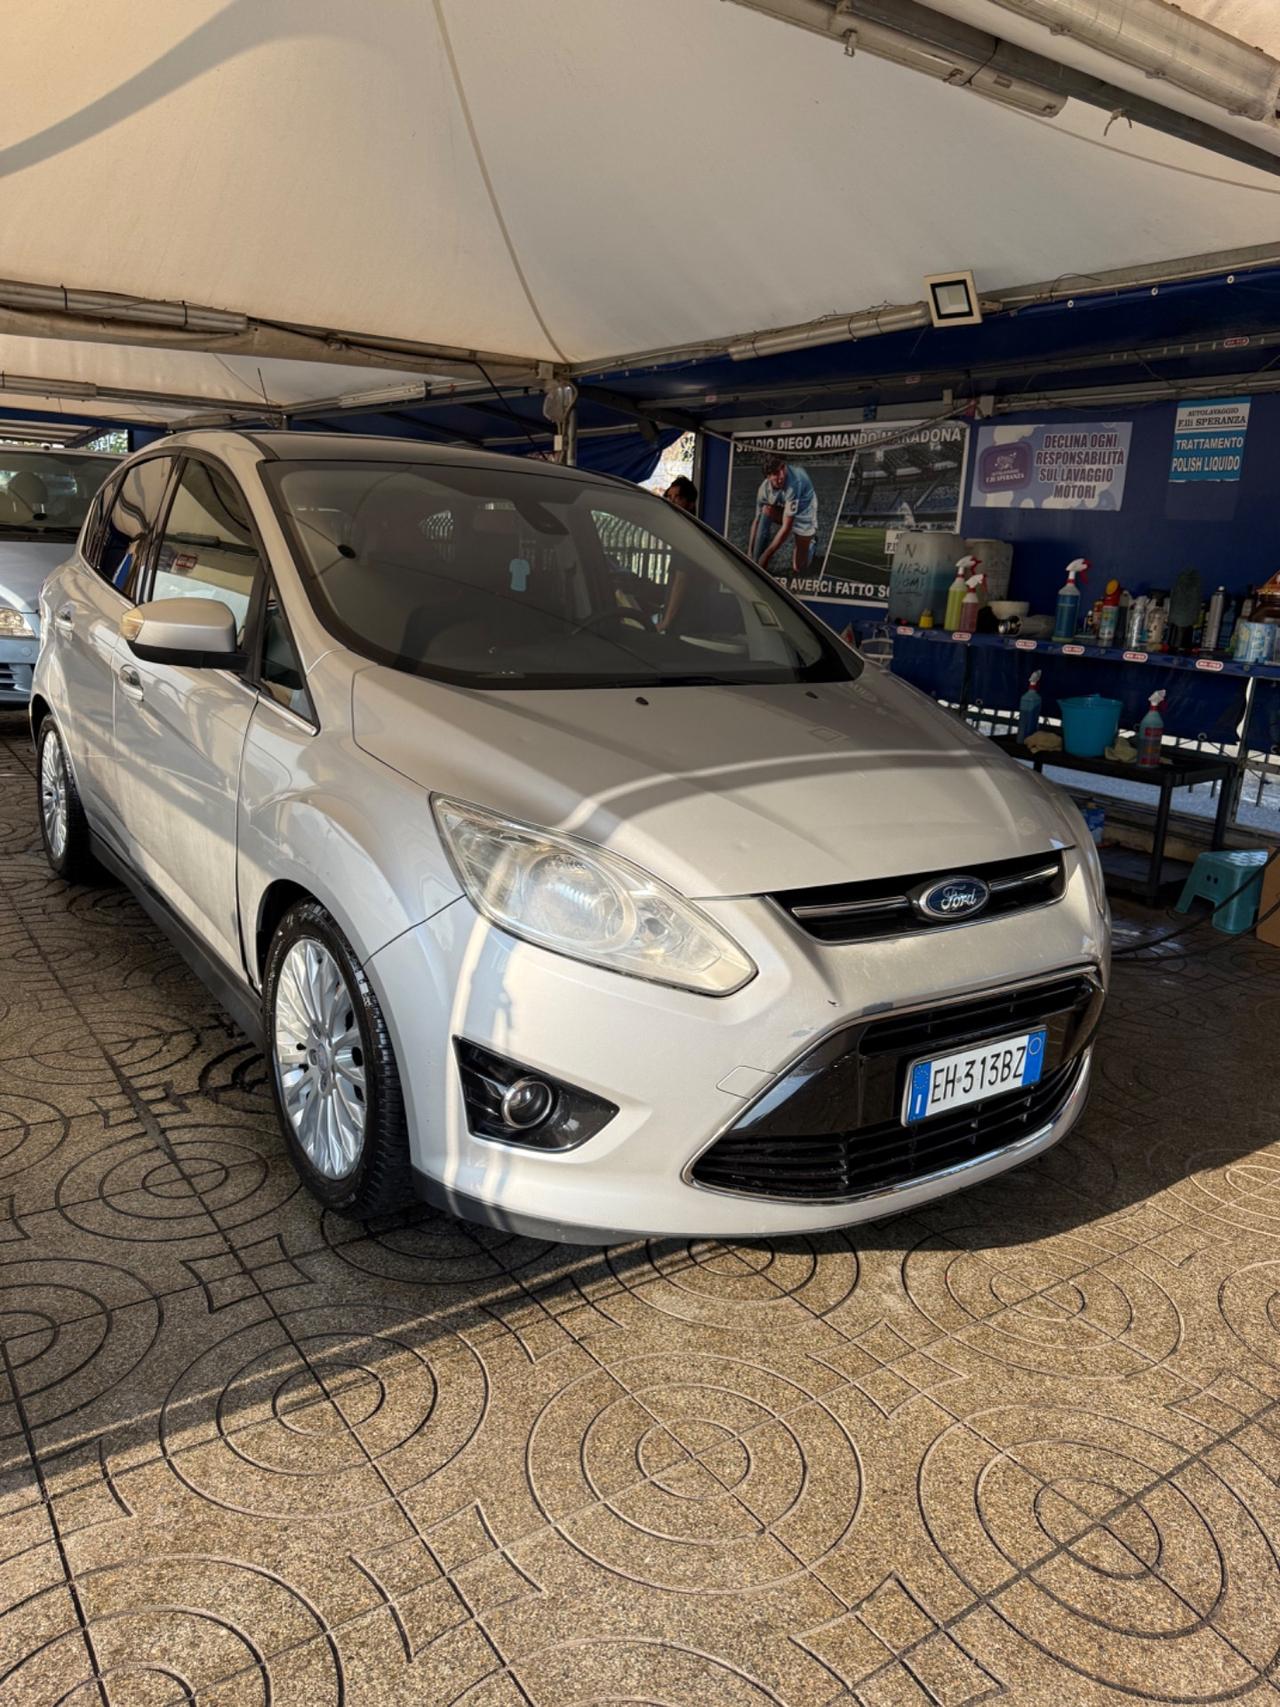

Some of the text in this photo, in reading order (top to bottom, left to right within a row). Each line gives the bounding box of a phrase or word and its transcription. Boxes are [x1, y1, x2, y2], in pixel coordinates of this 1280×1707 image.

[1187, 407, 1239, 417] AUTOLAVAGGIO
[1195, 416, 1246, 426] SPERANZA
[776, 436, 813, 450] DIEGO
[814, 431, 878, 449] ARMANDO
[1044, 433, 1117, 448] DECLINA OGNI
[1175, 437, 1244, 450] TRATTAMENTO
[1035, 448, 1124, 465] RESPONSABILITÀ
[1171, 455, 1240, 472] POLISH LIQUIDO
[1039, 468, 1114, 482] SUL LAVAGGIO
[1053, 484, 1097, 499] MOTORI
[774, 577, 787, 589] ER
[789, 577, 833, 593] AVERCI
[834, 582, 874, 597] FATTO
[941, 884, 977, 911] Ford
